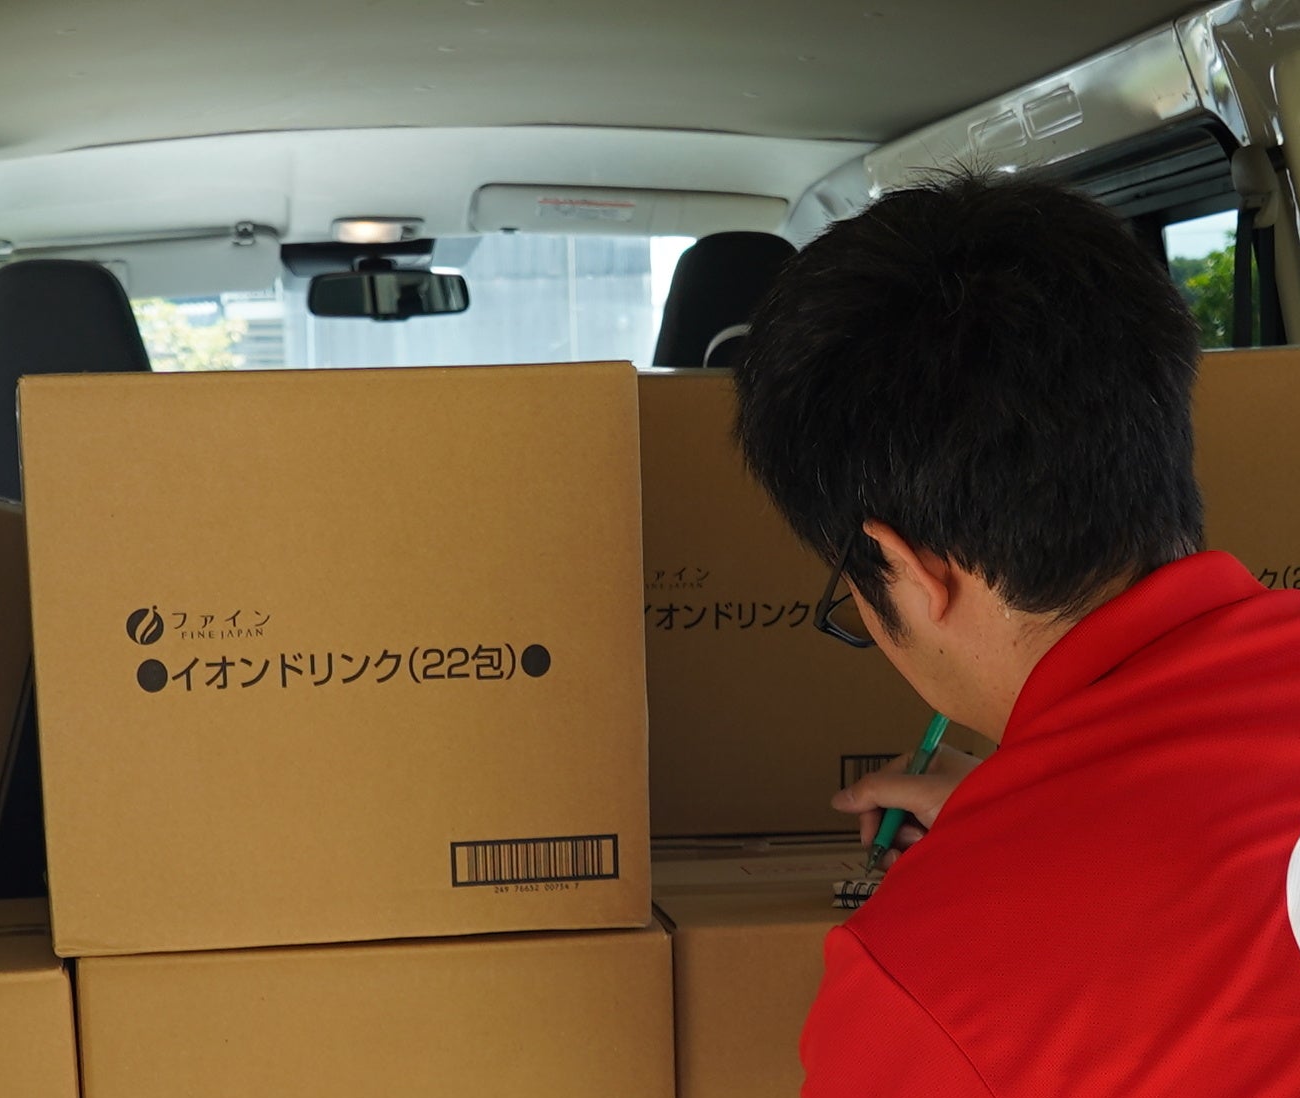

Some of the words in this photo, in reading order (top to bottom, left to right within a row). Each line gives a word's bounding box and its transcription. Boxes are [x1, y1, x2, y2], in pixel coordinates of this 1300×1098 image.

[172, 610, 270, 629] ファイン
[181, 628, 214, 640] FINE
[221, 628, 263, 639] JAPAN
